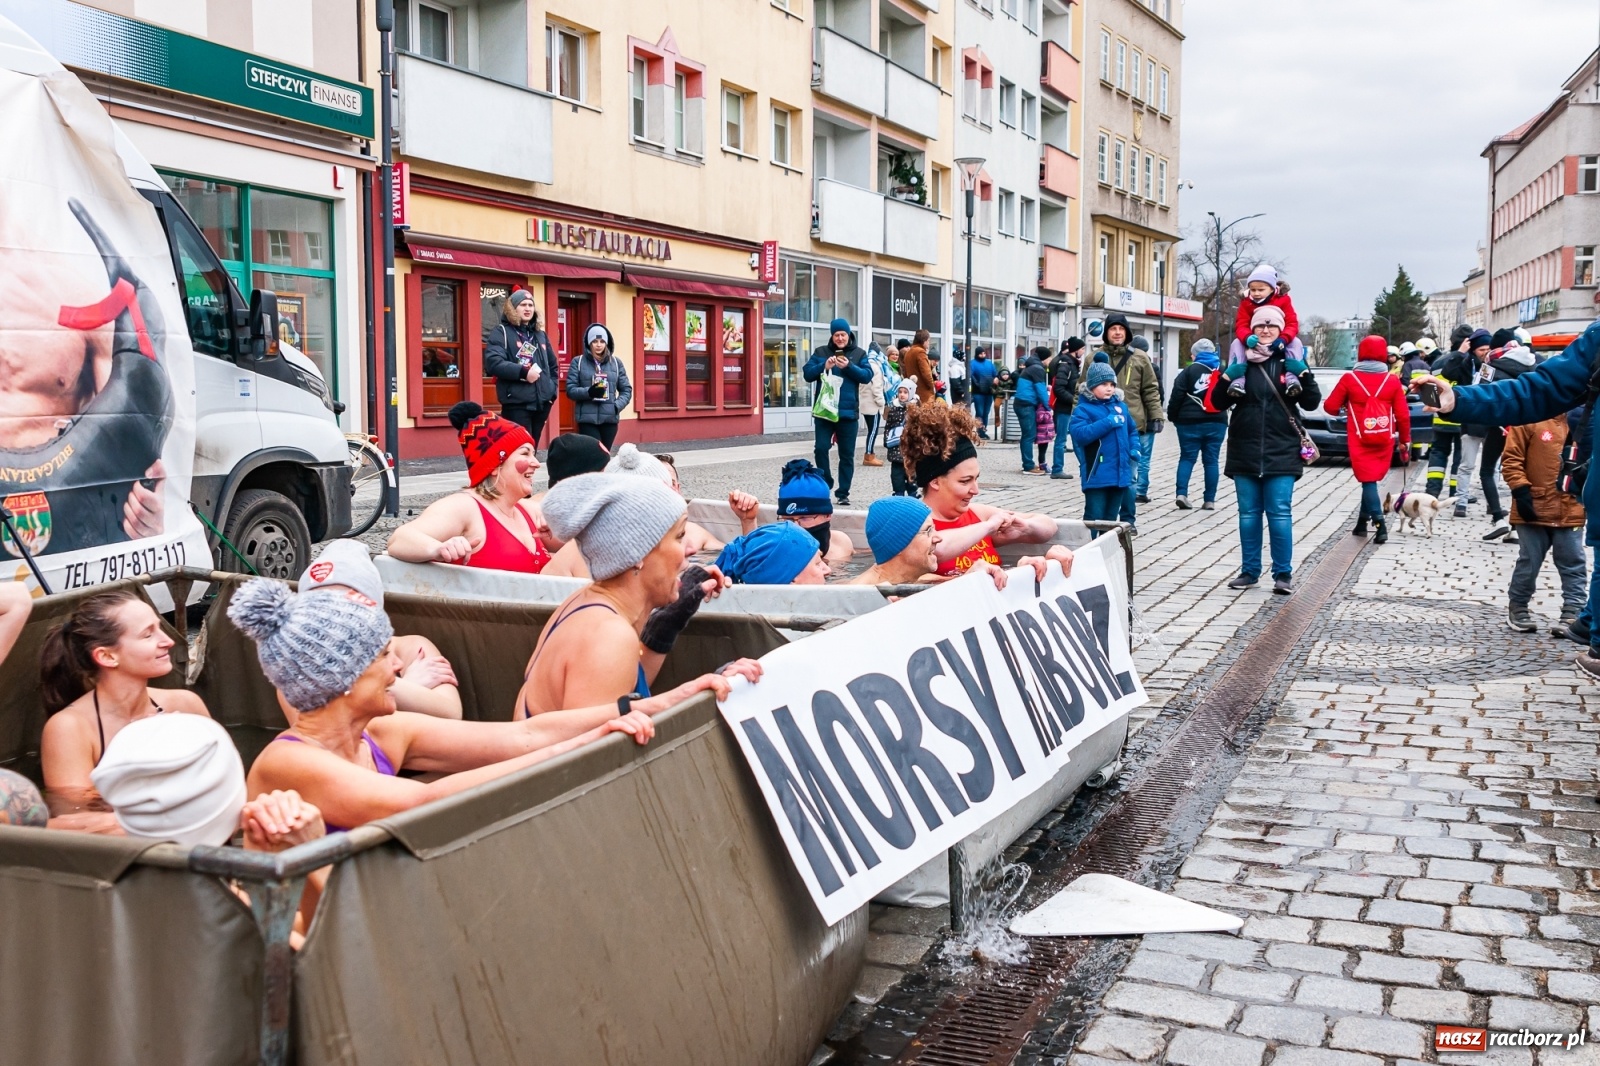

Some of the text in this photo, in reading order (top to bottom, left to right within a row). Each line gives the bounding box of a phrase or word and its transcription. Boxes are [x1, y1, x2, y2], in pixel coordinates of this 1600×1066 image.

[250, 66, 357, 110] STEFCZYK FINANSE
[551, 221, 672, 260] RESTAURACJA
[765, 244, 775, 279] ŻYWIEC
[895, 292, 918, 316] empik
[0, 443, 75, 483] BULGARIAN
[64, 541, 186, 590] TEL. 797-817-117
[955, 555, 972, 570] 40
[740, 626, 1026, 898] MORSY
